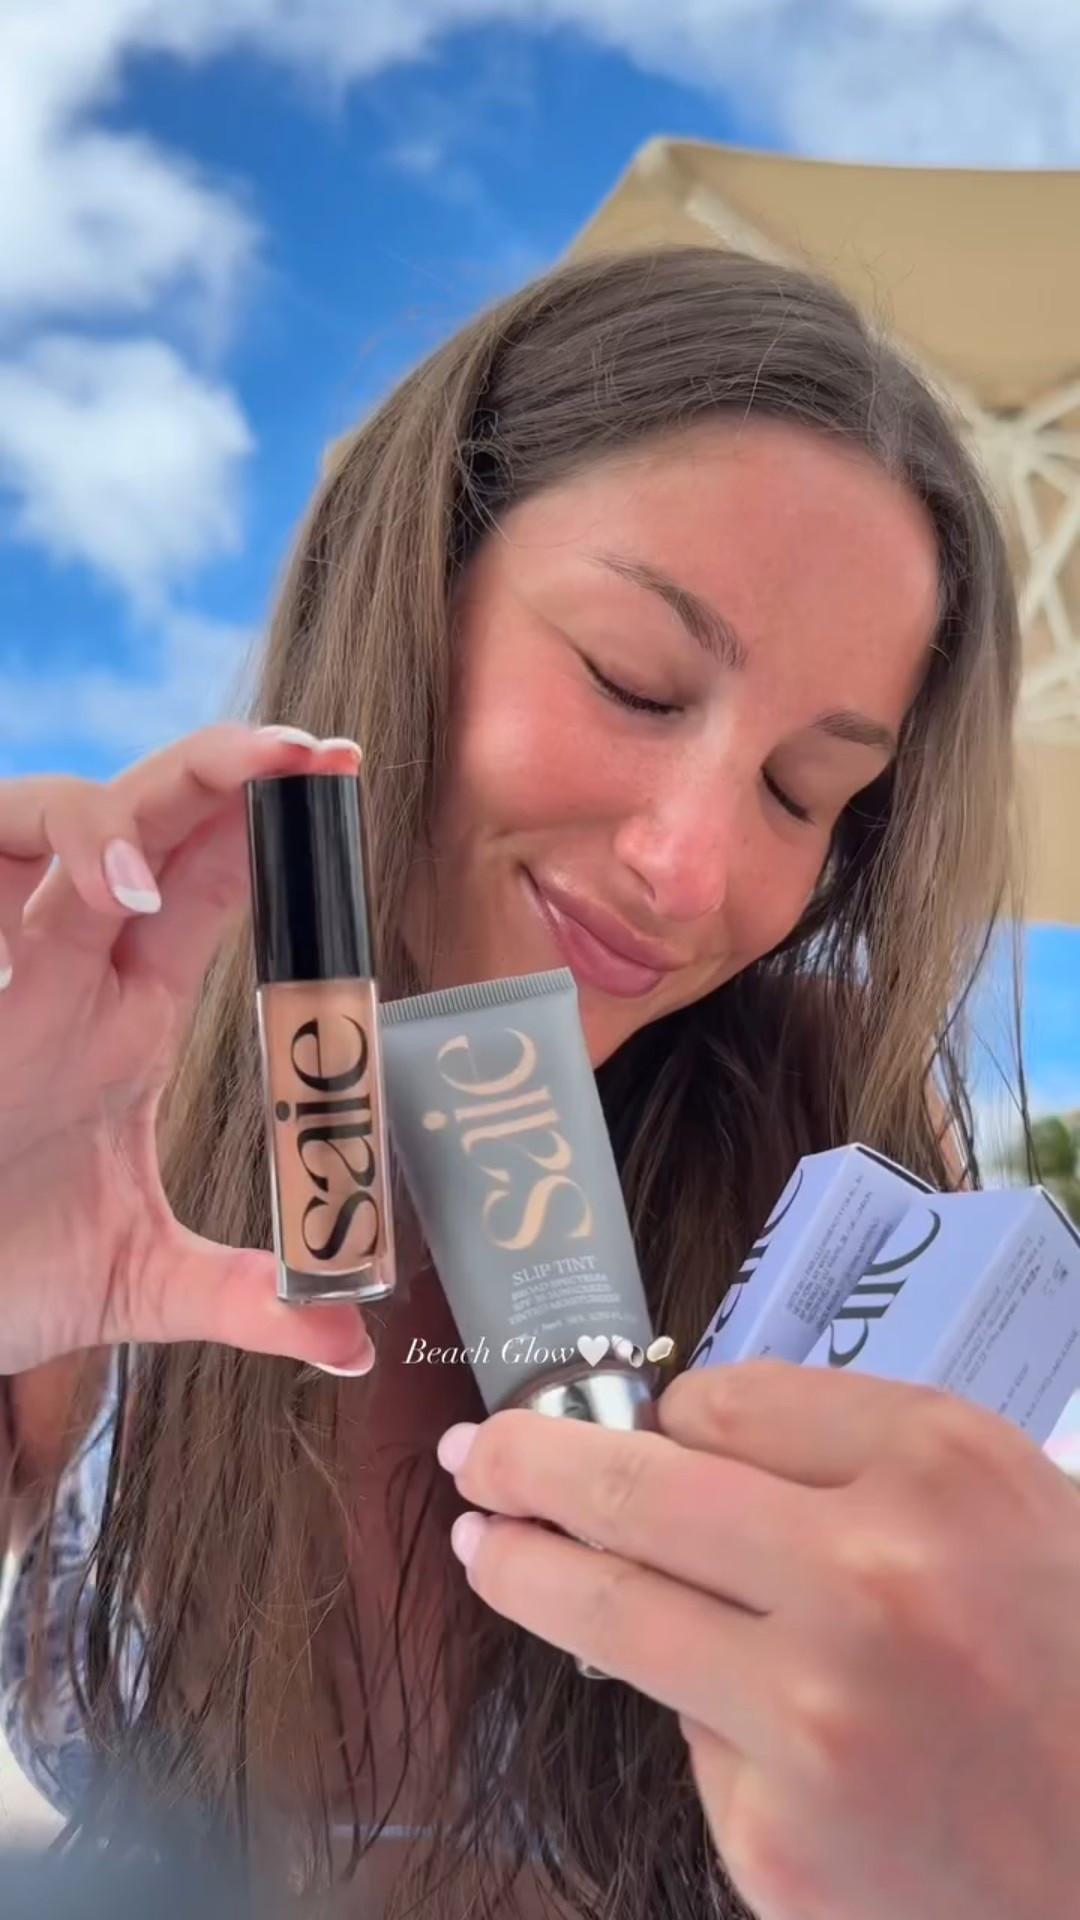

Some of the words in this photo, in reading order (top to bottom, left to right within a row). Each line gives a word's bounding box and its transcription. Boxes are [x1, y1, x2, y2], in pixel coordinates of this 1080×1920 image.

[275, 1014, 379, 1261] saie
[422, 1027, 593, 1251] saie
[511, 1263, 551, 1286] SLIP
[553, 1255, 597, 1274] TINT
